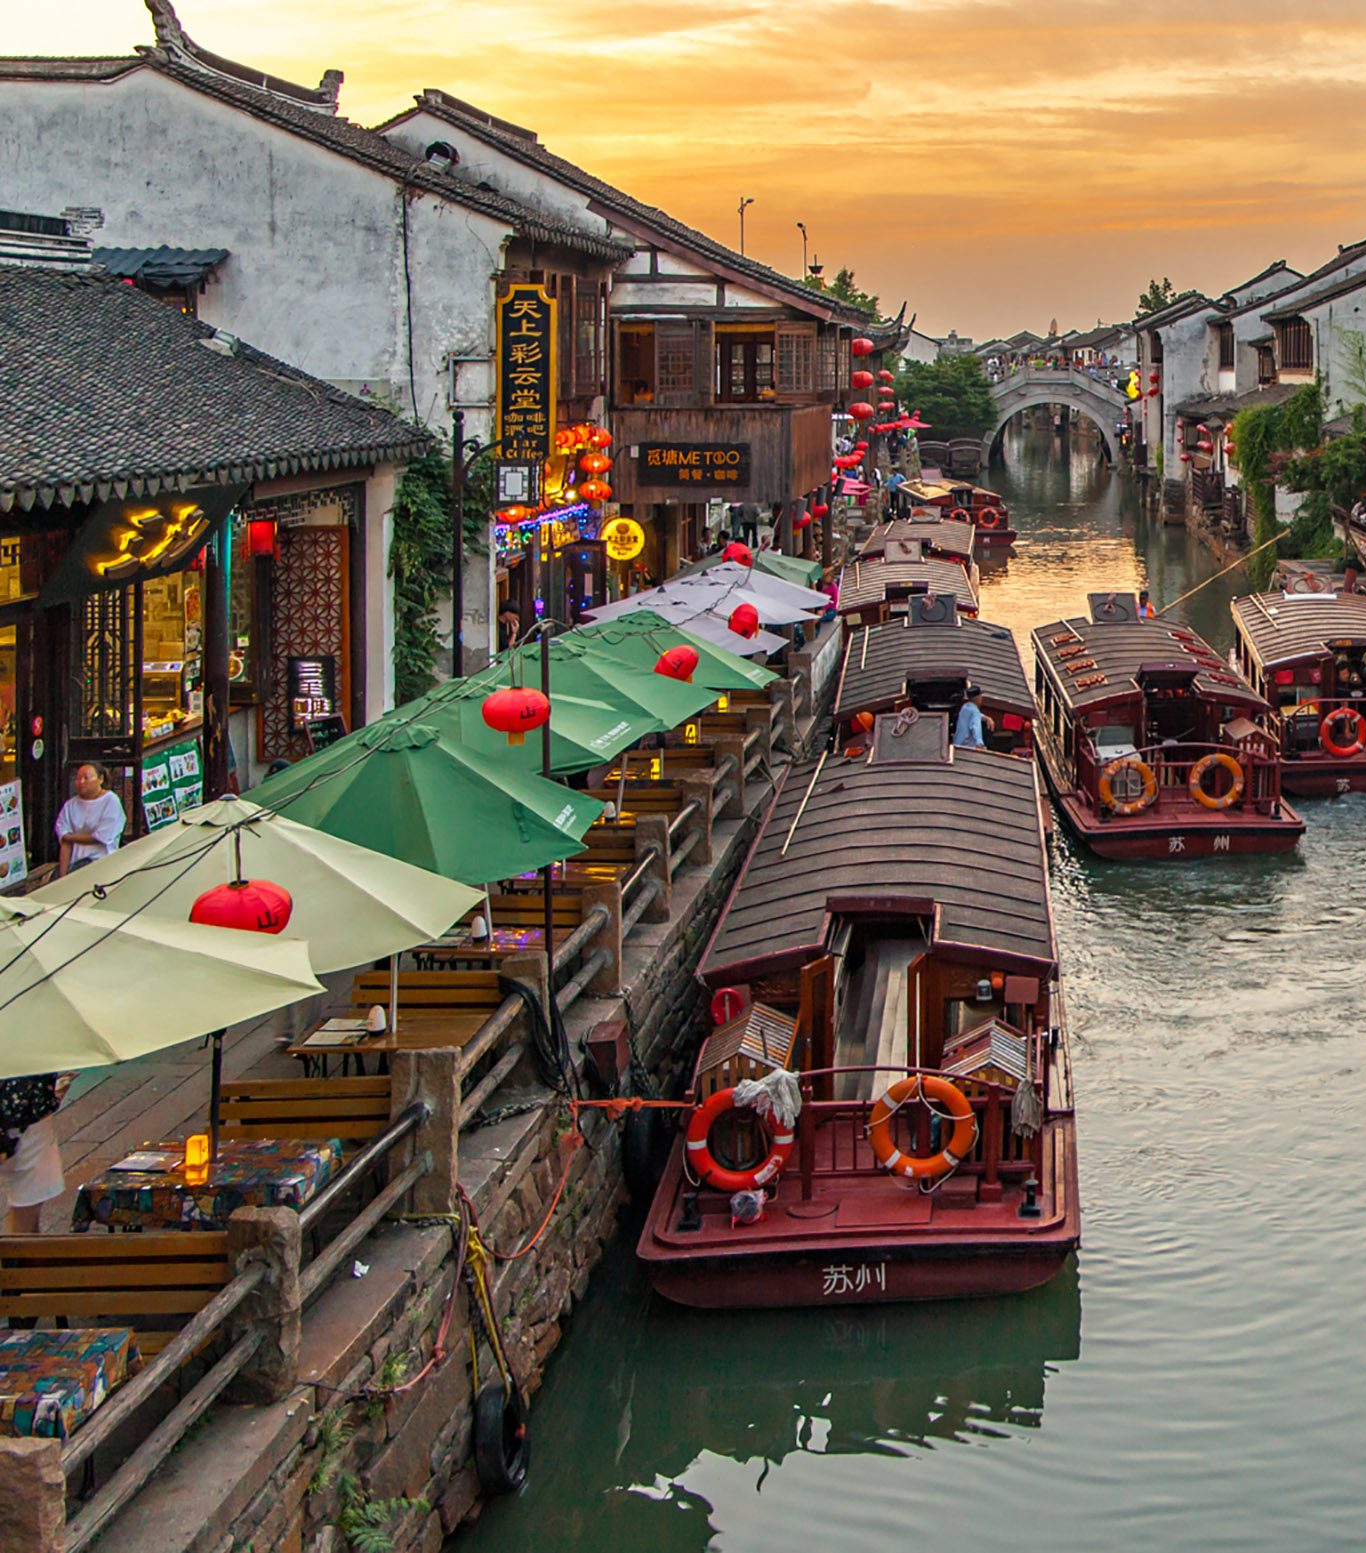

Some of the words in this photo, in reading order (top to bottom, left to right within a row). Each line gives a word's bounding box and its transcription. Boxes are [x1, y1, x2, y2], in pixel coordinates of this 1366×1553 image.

[508, 300, 543, 411] 天上彩云堂
[678, 451, 700, 465] ME
[704, 450, 740, 465] TOO
[1168, 835, 1230, 853] 苏州
[822, 1263, 886, 1295] 苏州
